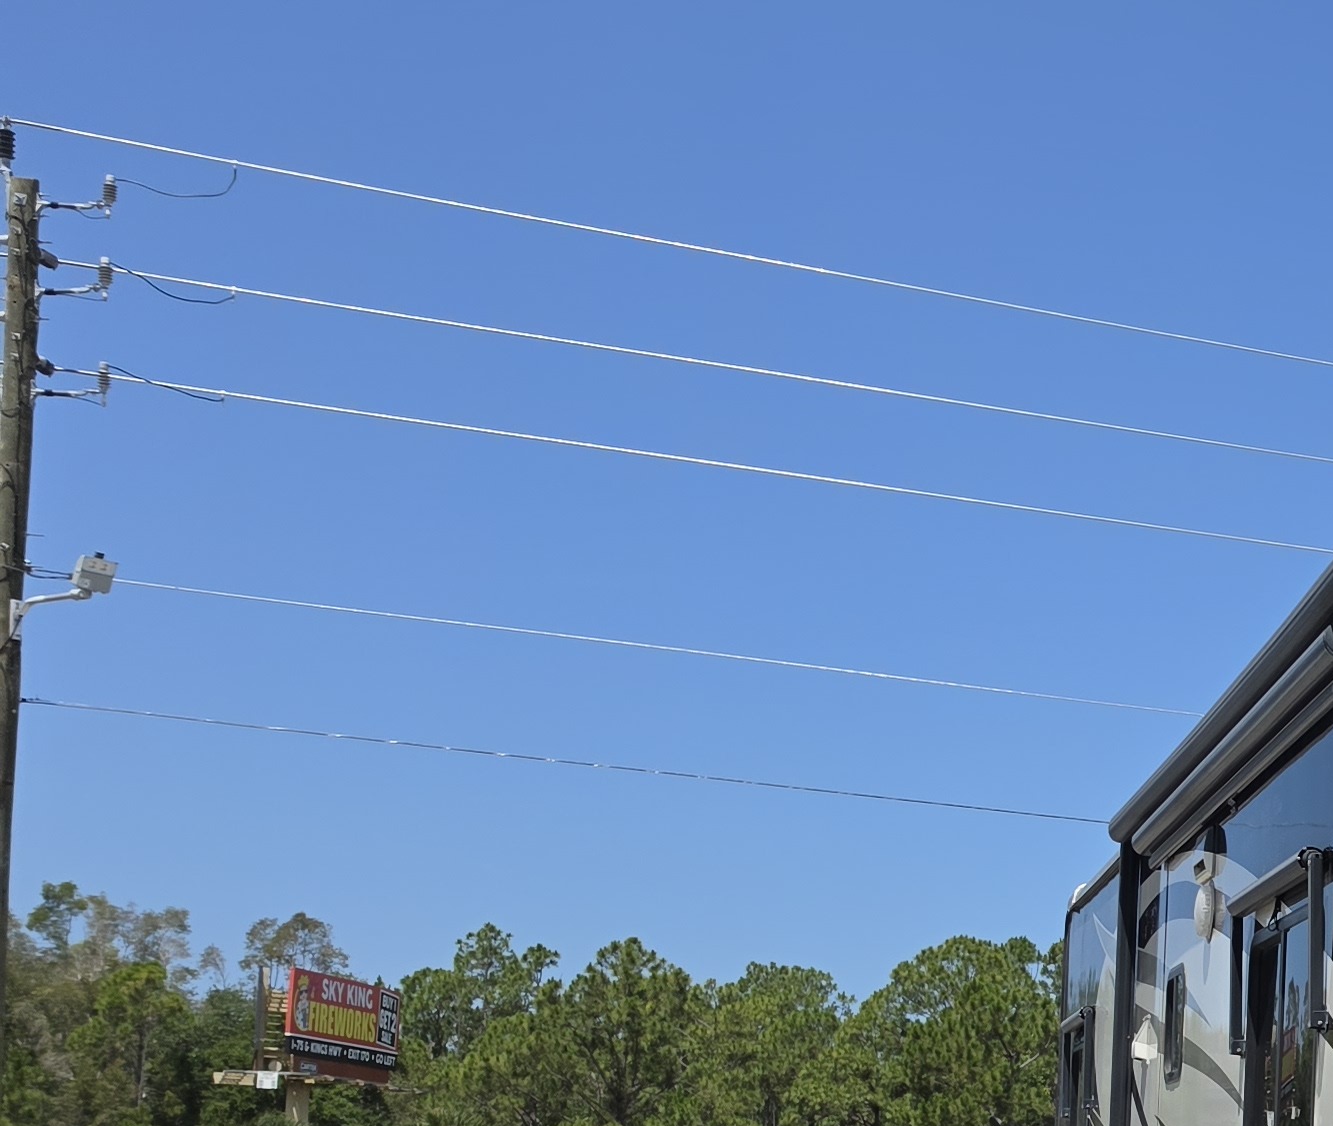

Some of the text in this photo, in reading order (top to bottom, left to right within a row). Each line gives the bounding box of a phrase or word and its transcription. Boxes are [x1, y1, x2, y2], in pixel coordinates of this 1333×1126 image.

[322, 978, 373, 1009] SKY KING
[382, 995, 394, 1011] BUY
[308, 1001, 377, 1043] FIREWORKS
[379, 1009, 397, 1034] GET 2
[310, 1043, 328, 1056] KINGS
[328, 1045, 342, 1058] HWY
[347, 1048, 360, 1061] EXIT
[375, 1054, 383, 1065] GO
[384, 1055, 396, 1067] LEFT
